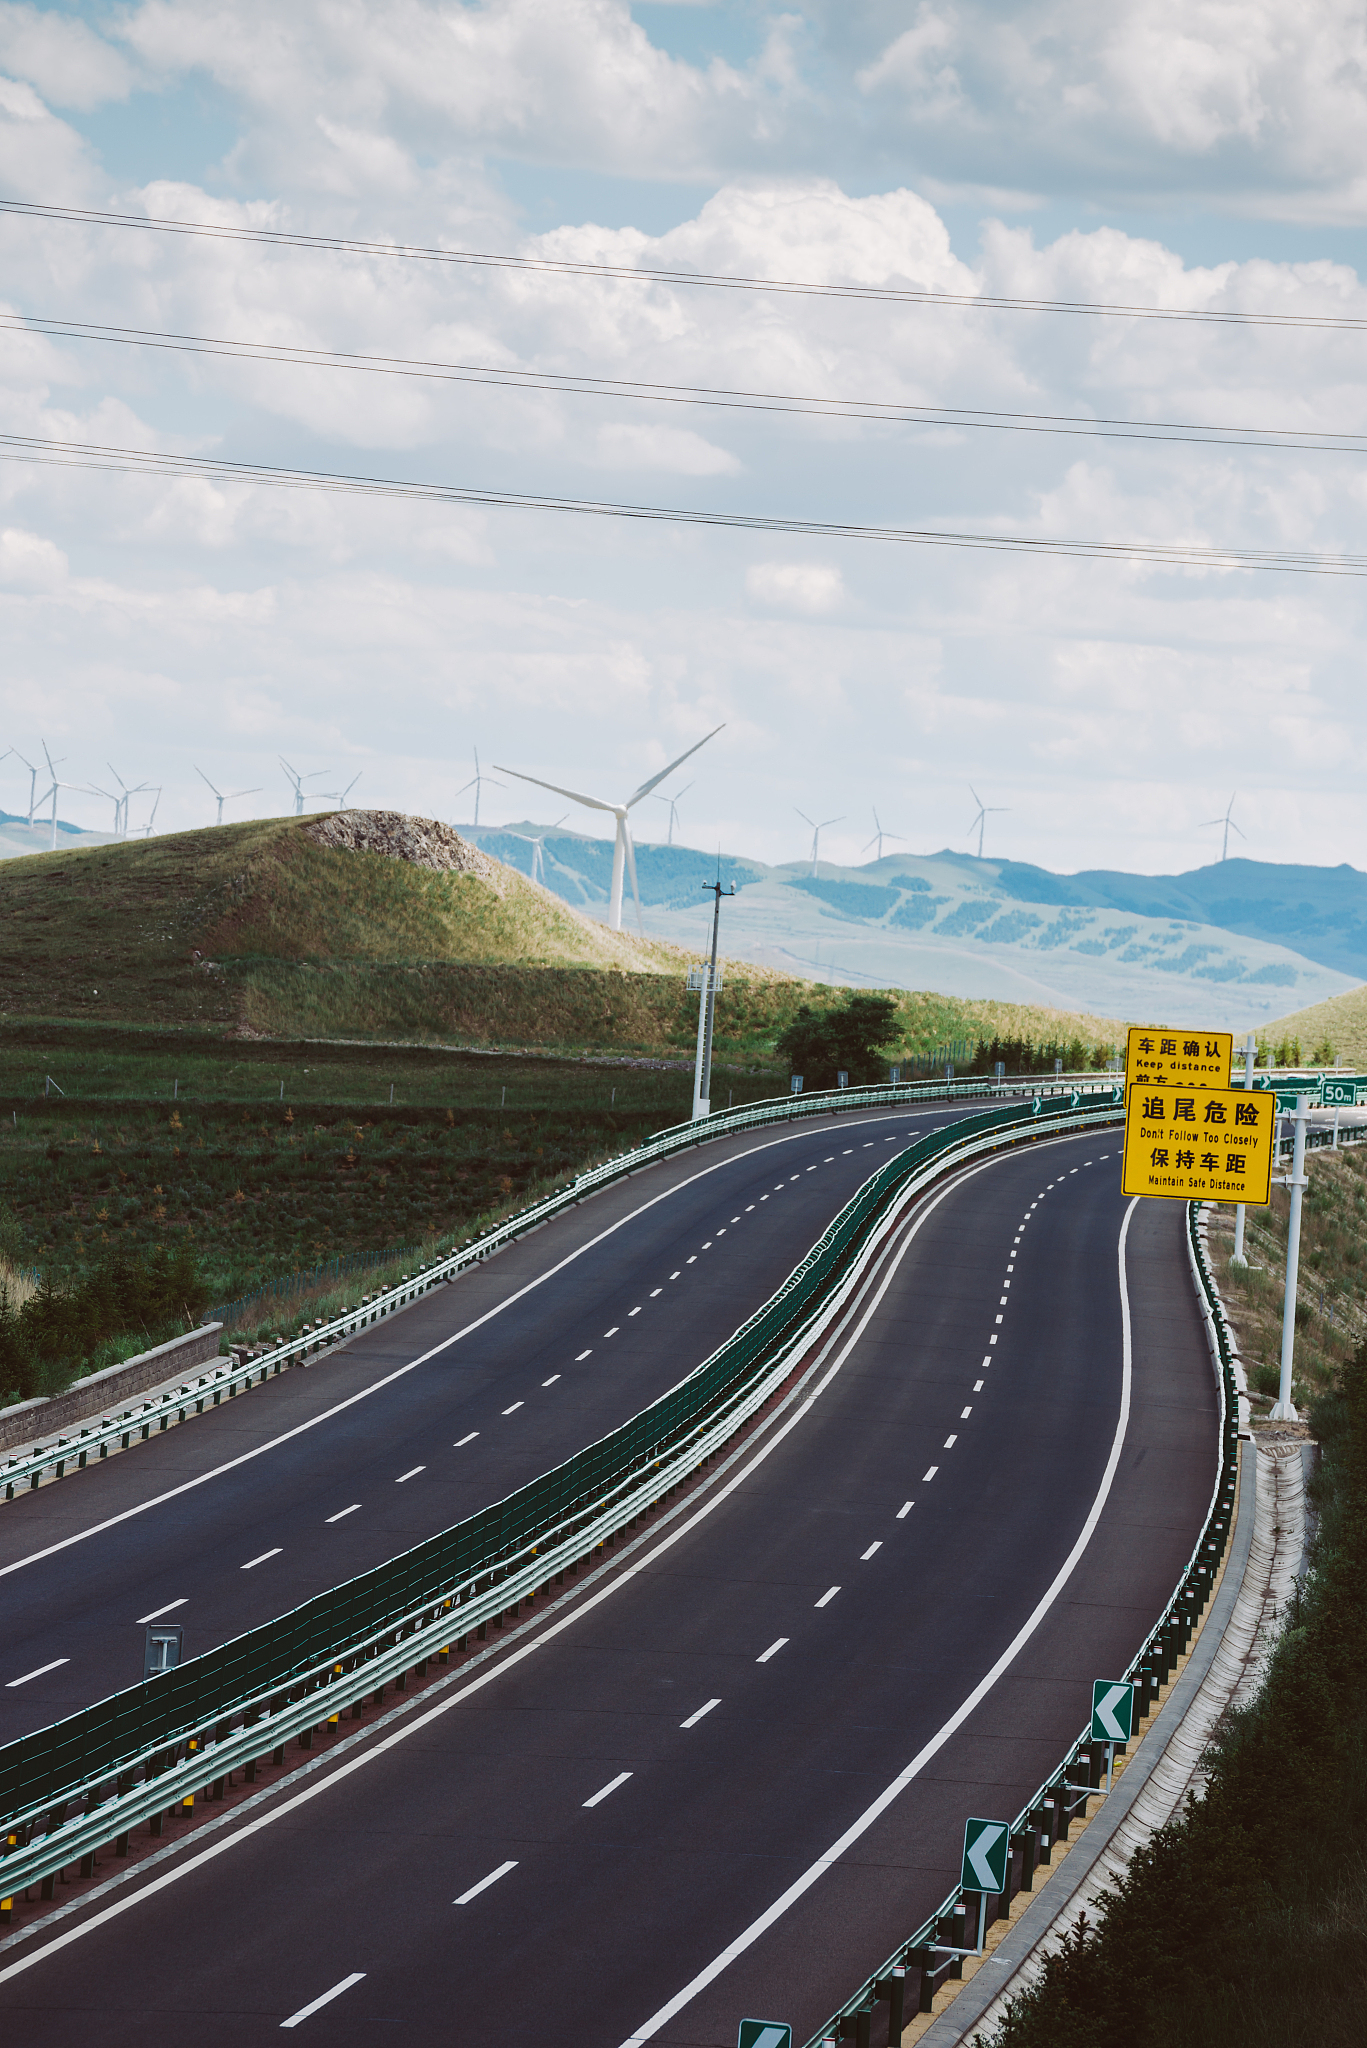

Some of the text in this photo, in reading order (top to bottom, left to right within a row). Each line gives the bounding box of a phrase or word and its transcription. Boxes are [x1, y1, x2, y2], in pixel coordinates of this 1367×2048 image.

[1138, 1037, 1221, 1058] 车距确认
[1136, 1059, 1221, 1073] Keep distance
[1142, 1096, 1260, 1126] 追尾危险
[1169, 1129, 1199, 1142] Follow
[1203, 1131, 1219, 1144] Too
[1223, 1133, 1259, 1148] Closely
[1150, 1147, 1247, 1174] 保持车距
[1148, 1175, 1246, 1191] Maintain Safe Distance
